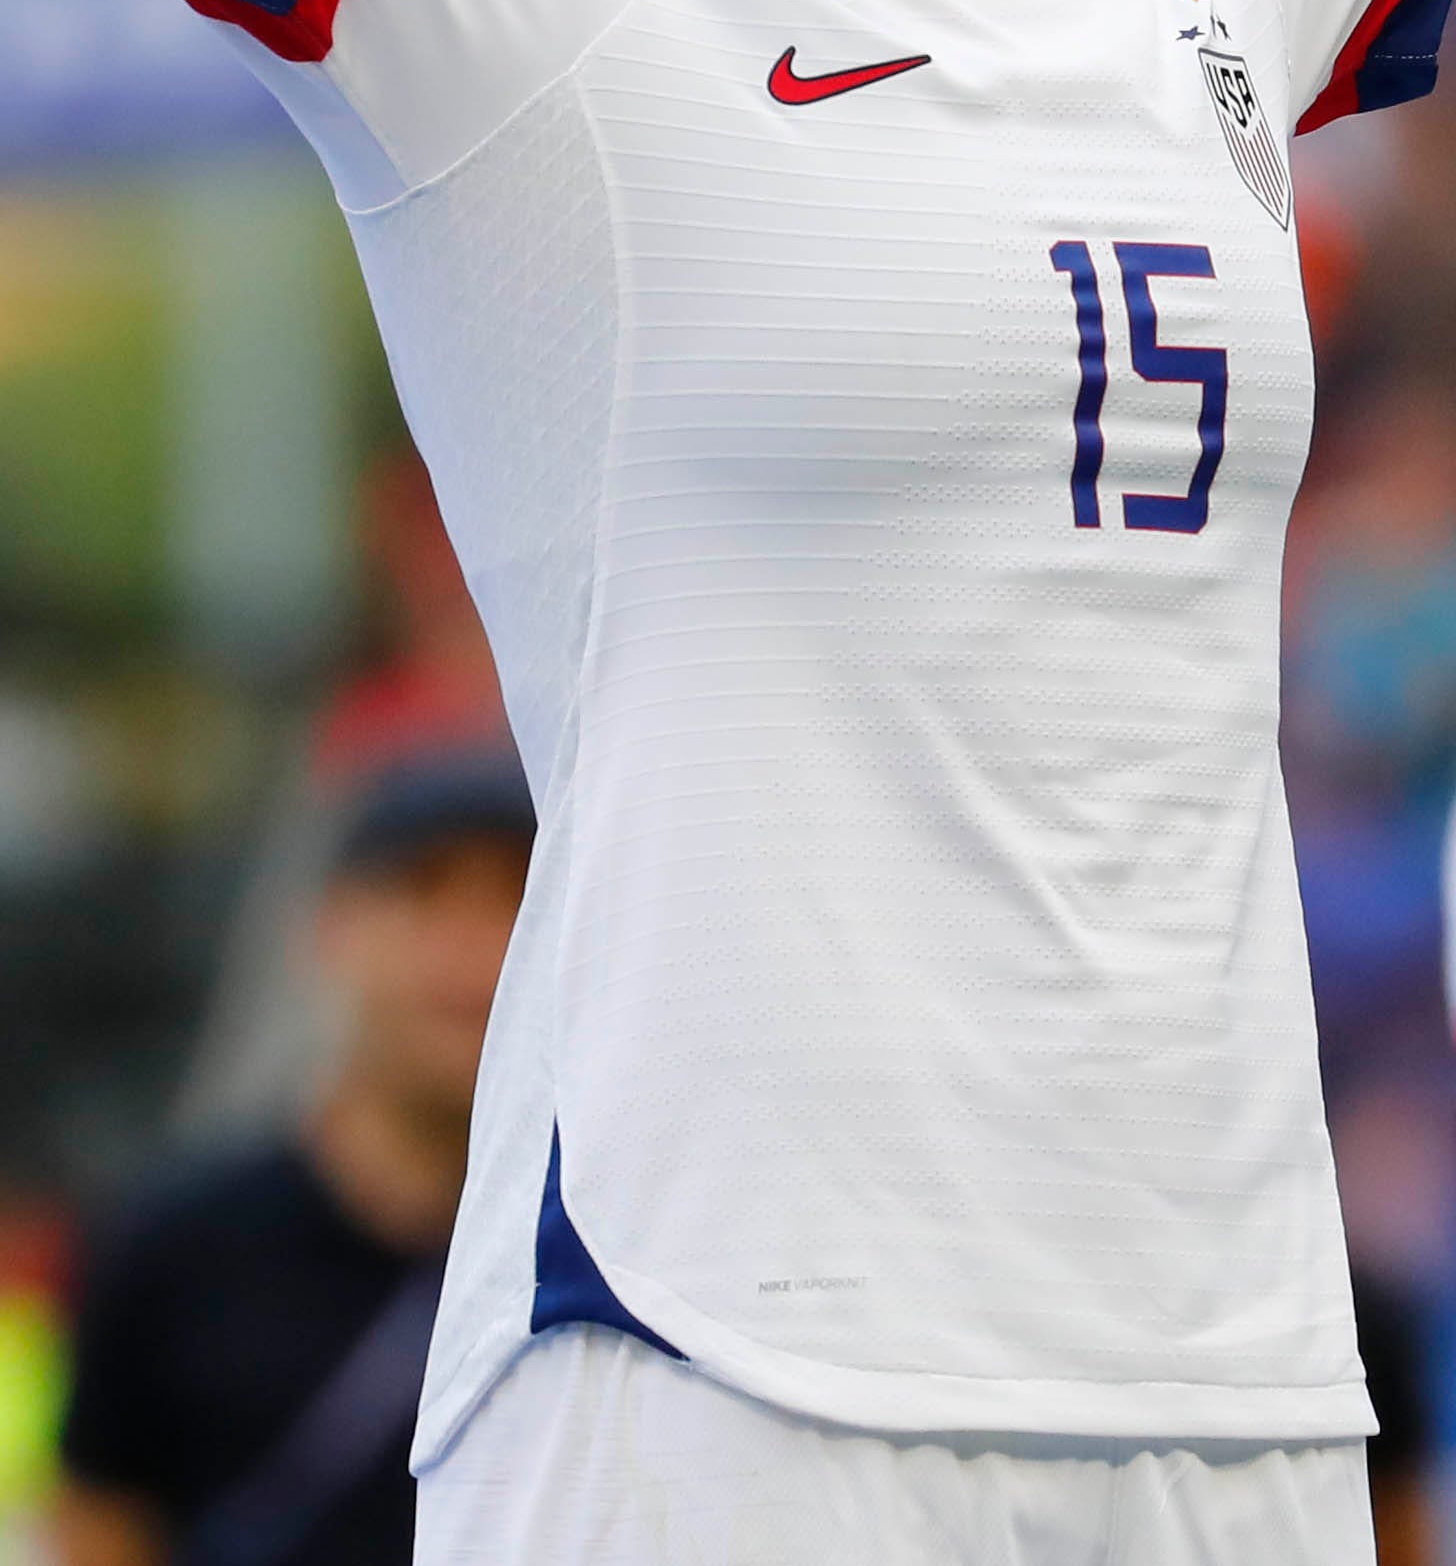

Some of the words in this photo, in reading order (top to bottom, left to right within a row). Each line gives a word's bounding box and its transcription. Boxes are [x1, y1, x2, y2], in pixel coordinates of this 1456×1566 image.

[1206, 61, 1256, 129] USA
[1048, 240, 1229, 535] 15
[758, 1280, 791, 1294] NIKE
